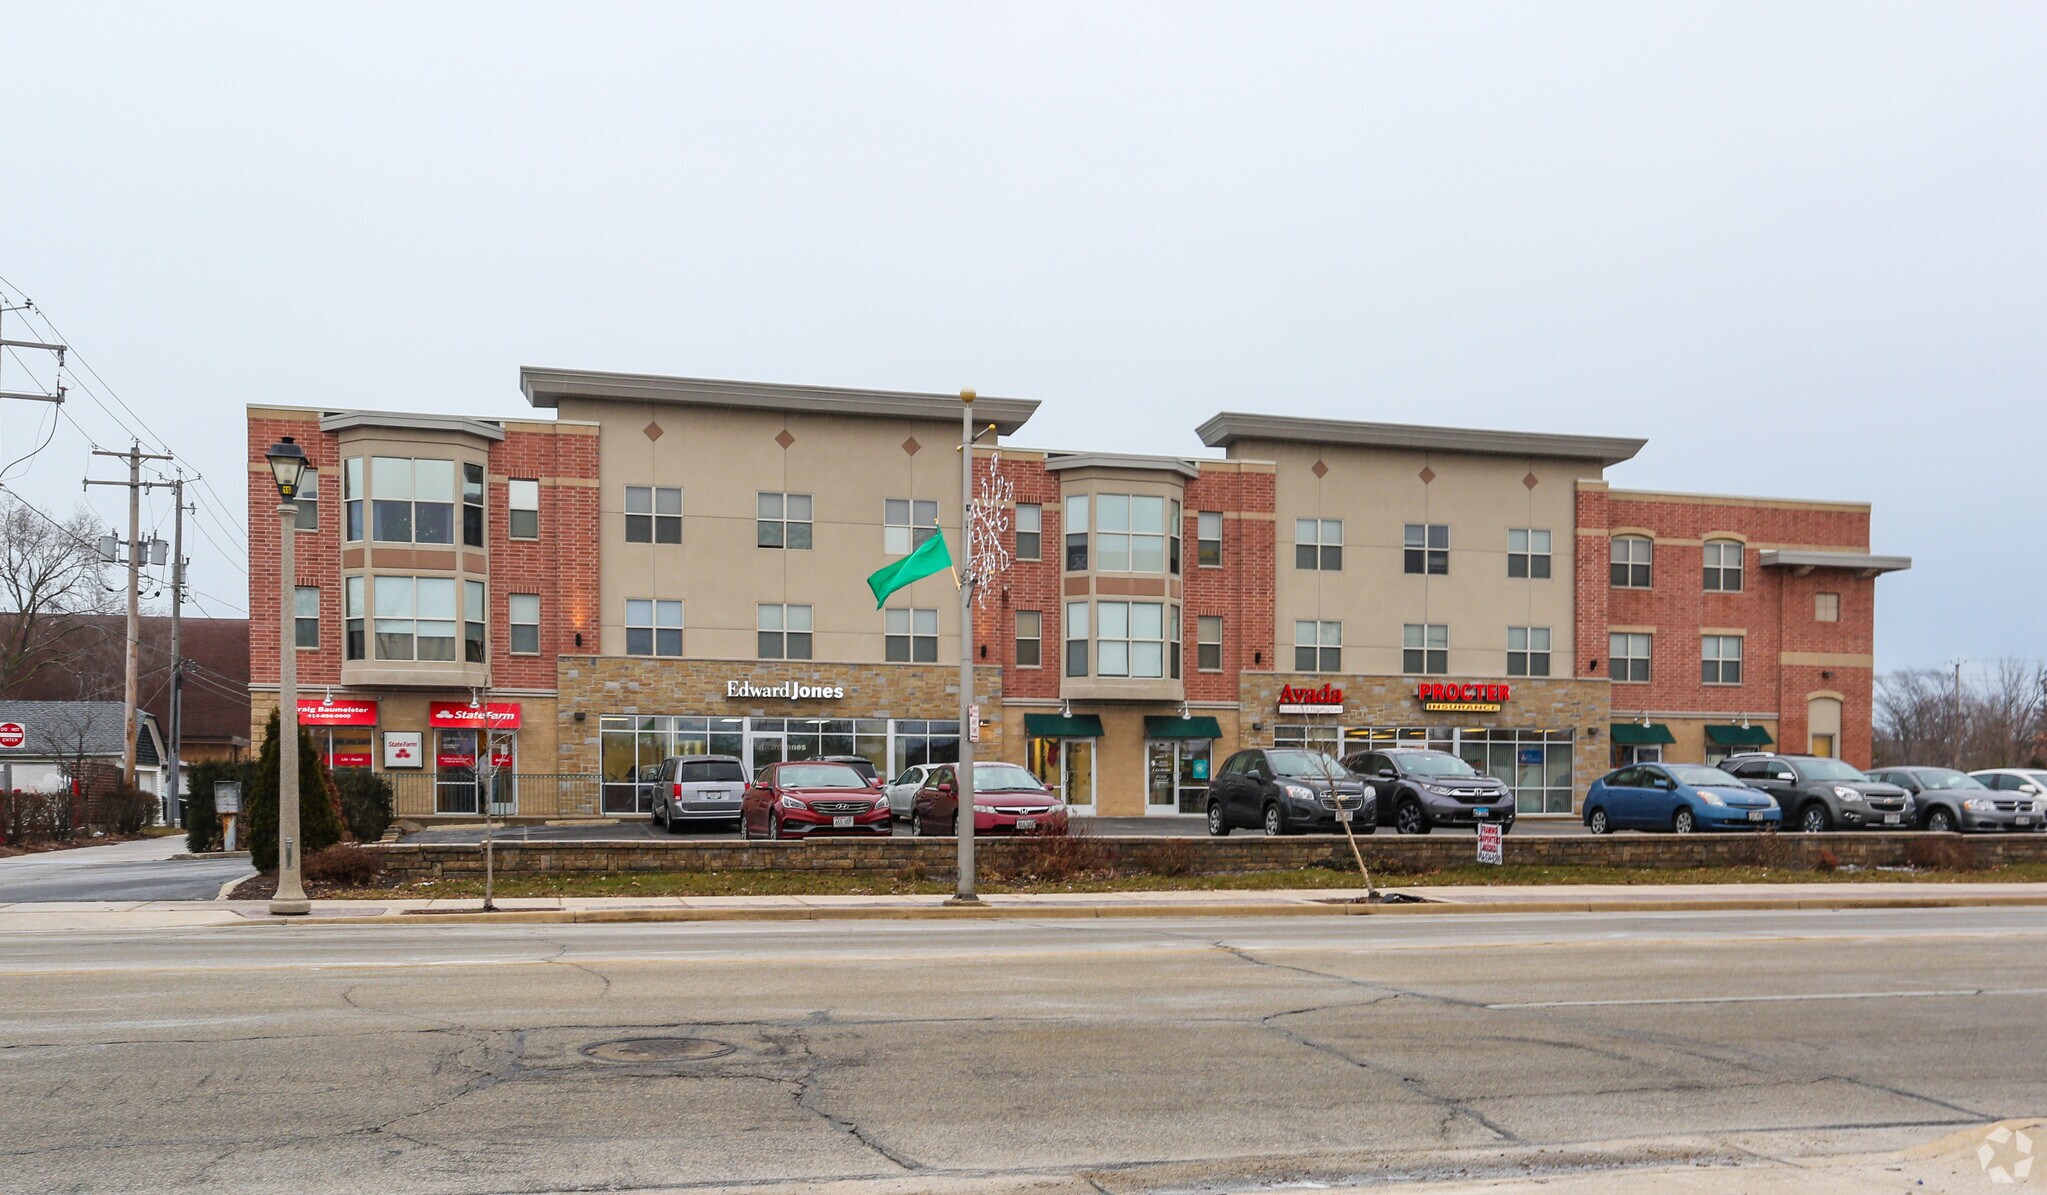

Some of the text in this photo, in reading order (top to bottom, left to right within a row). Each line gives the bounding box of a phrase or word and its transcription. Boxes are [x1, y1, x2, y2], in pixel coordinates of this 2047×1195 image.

[727, 681, 844, 700] Edward Jones
[1279, 683, 1344, 703] Avada
[1418, 683, 1511, 701] PROCTER
[1427, 703, 1498, 711] INSURANCE
